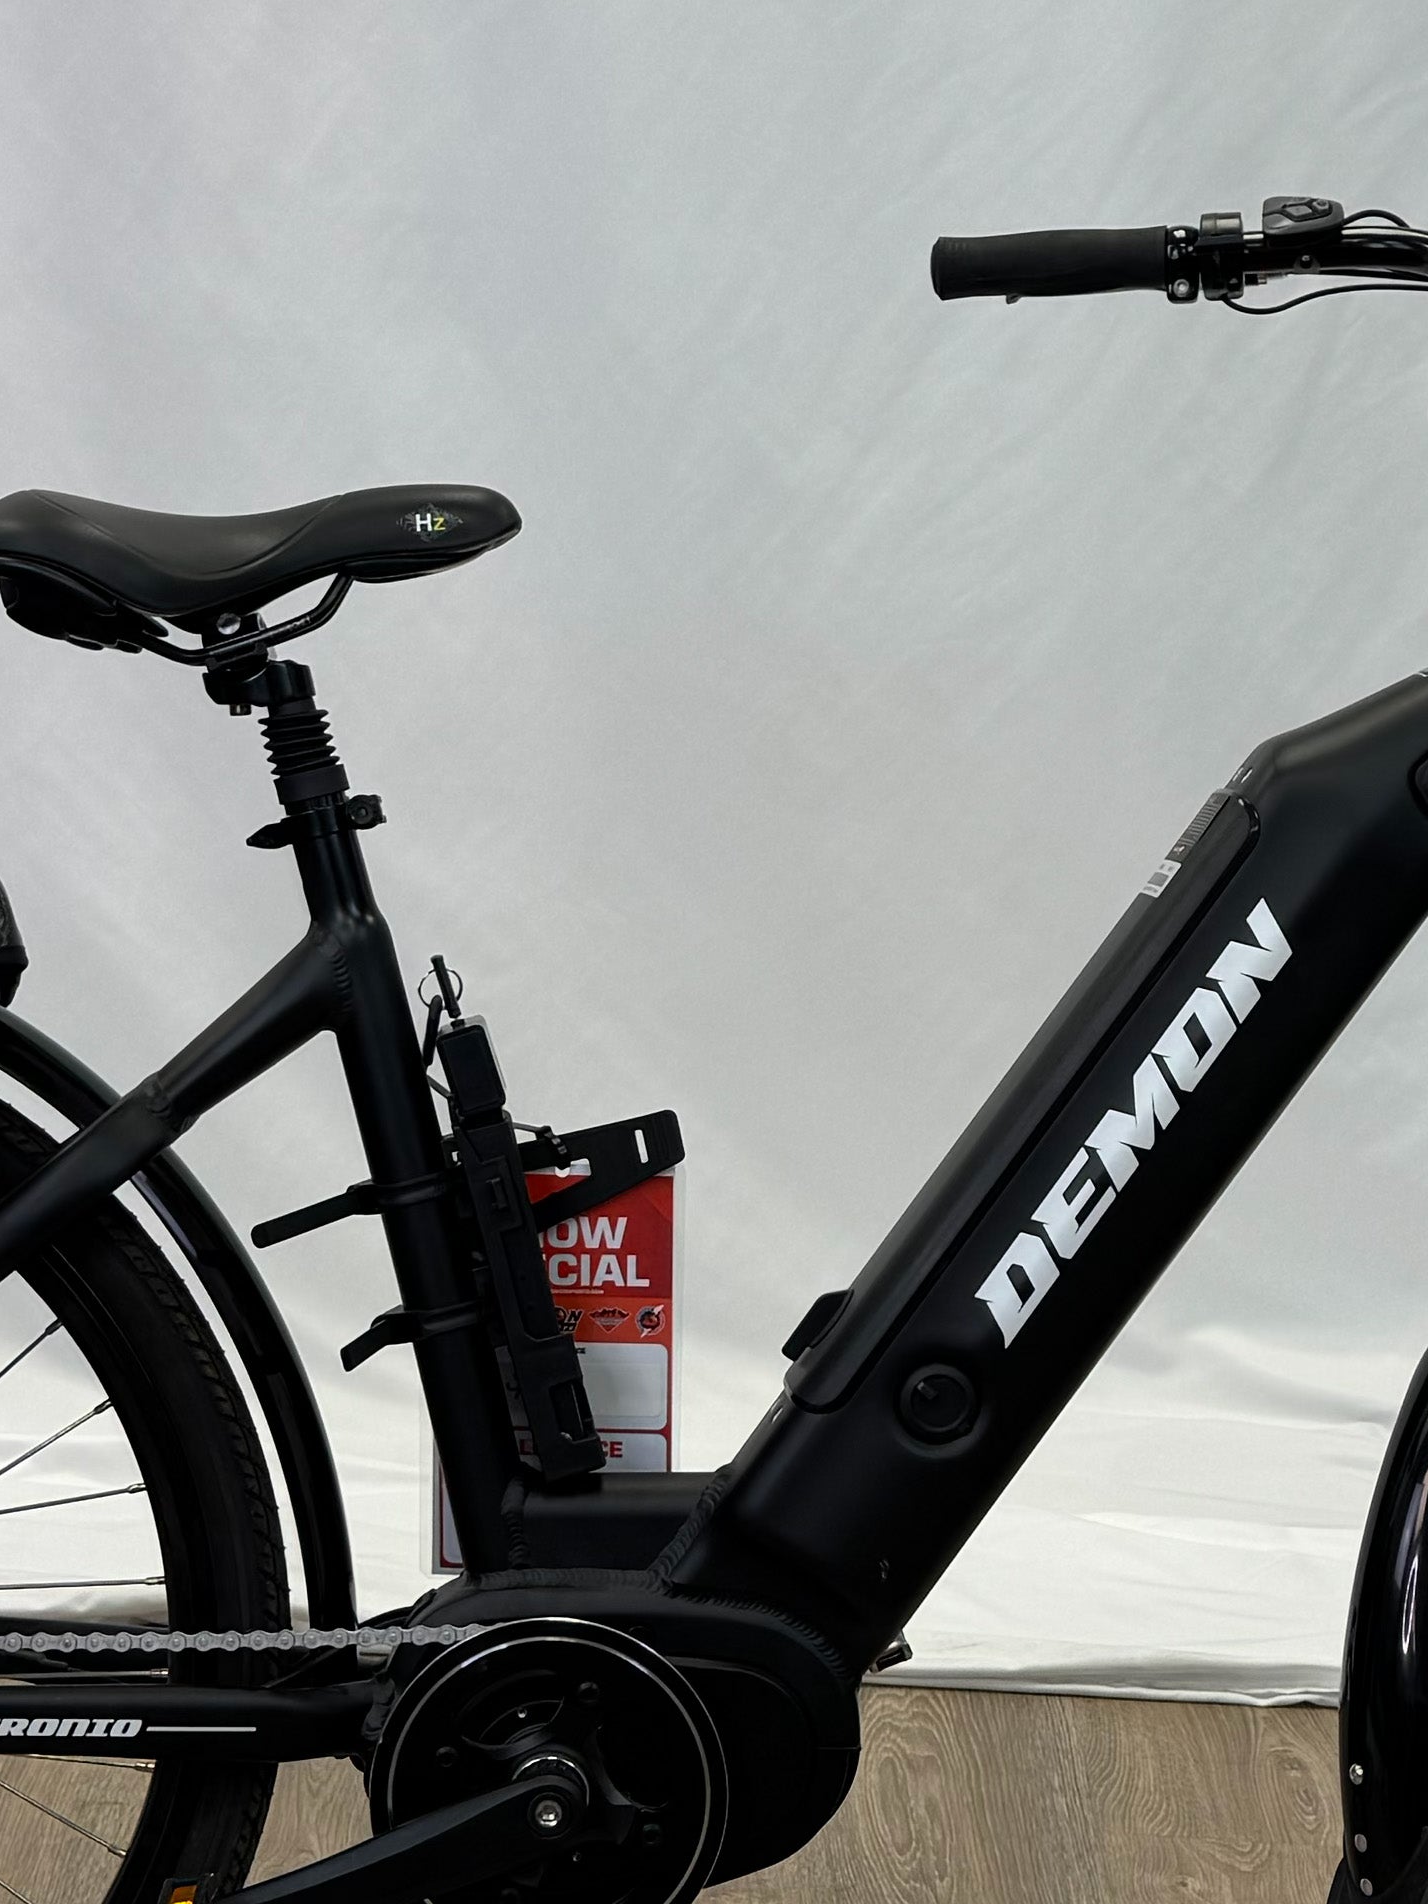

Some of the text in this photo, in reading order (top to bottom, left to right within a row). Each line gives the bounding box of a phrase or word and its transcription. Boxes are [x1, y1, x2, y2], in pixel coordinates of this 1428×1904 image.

[414, 512, 446, 532] Hz
[975, 898, 1293, 1349] DEMON
[543, 1254, 650, 1288] CIAL
